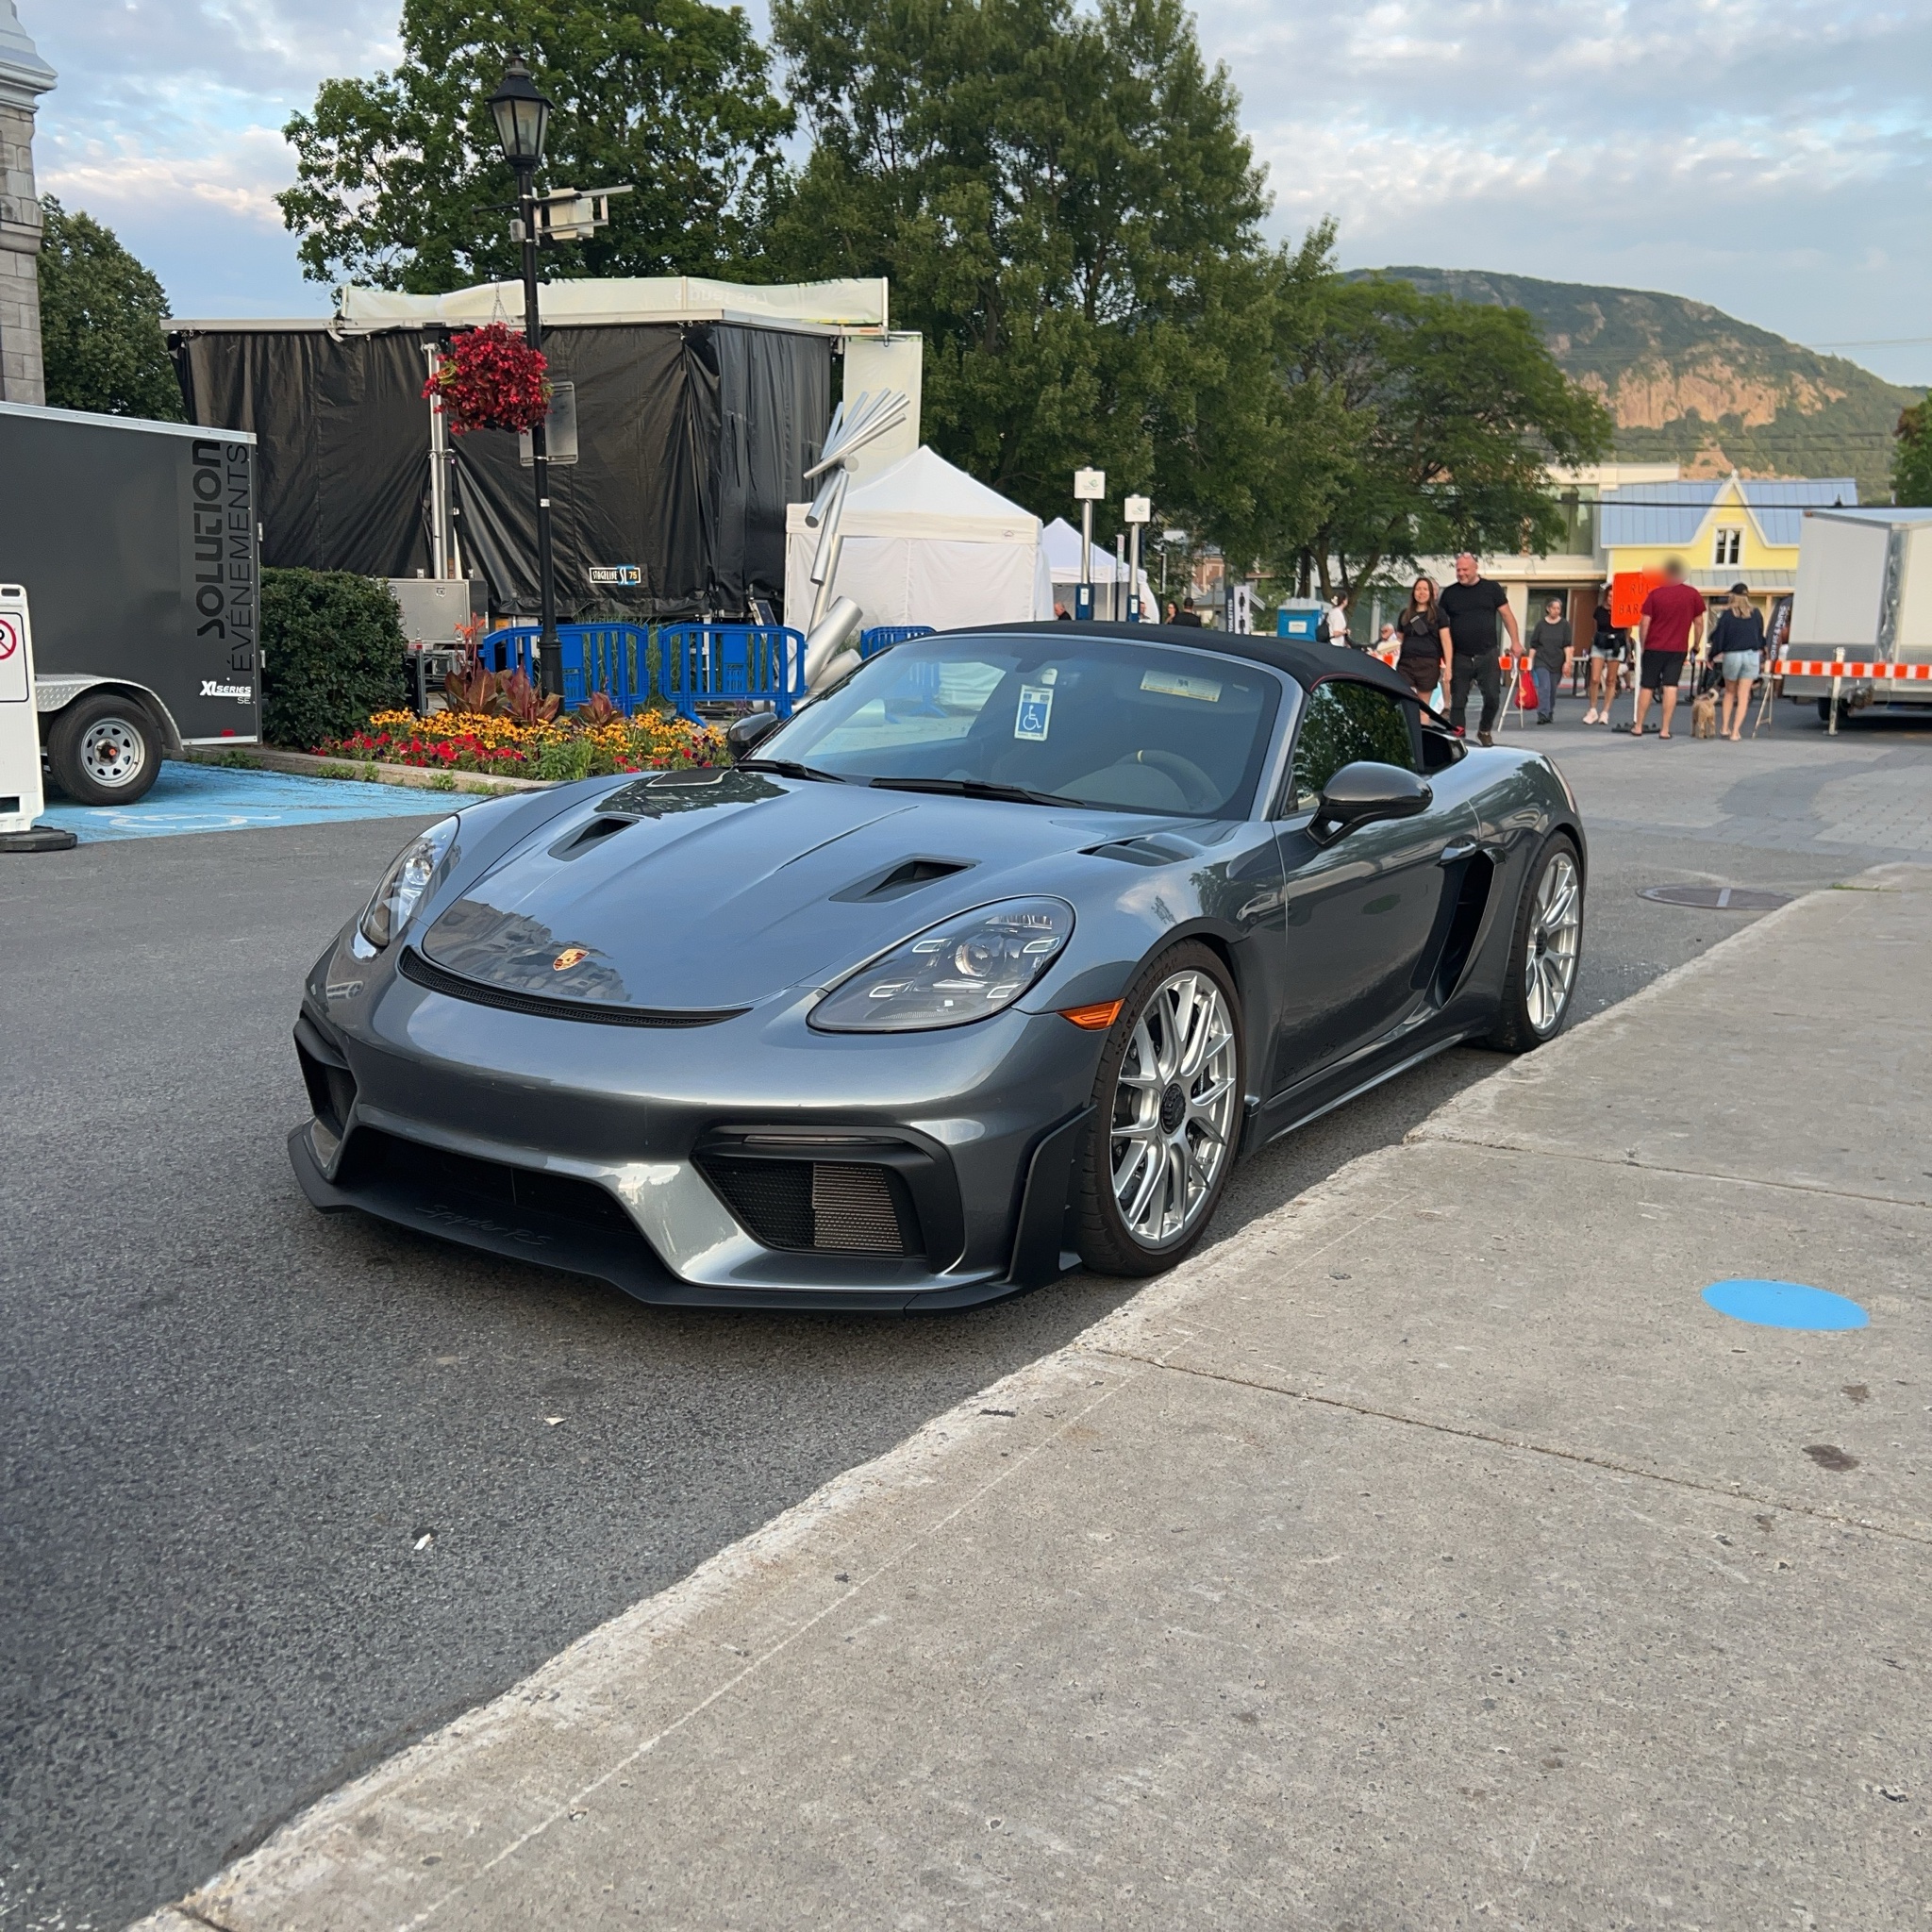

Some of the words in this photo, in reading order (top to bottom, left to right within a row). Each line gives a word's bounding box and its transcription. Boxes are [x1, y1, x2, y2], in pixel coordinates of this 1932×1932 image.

[225, 443, 252, 672] ÉVÉNEMENTS
[628, 571, 638, 580] 75
[1619, 603, 1641, 615] BAR
[503, 1228, 555, 1246] RS
